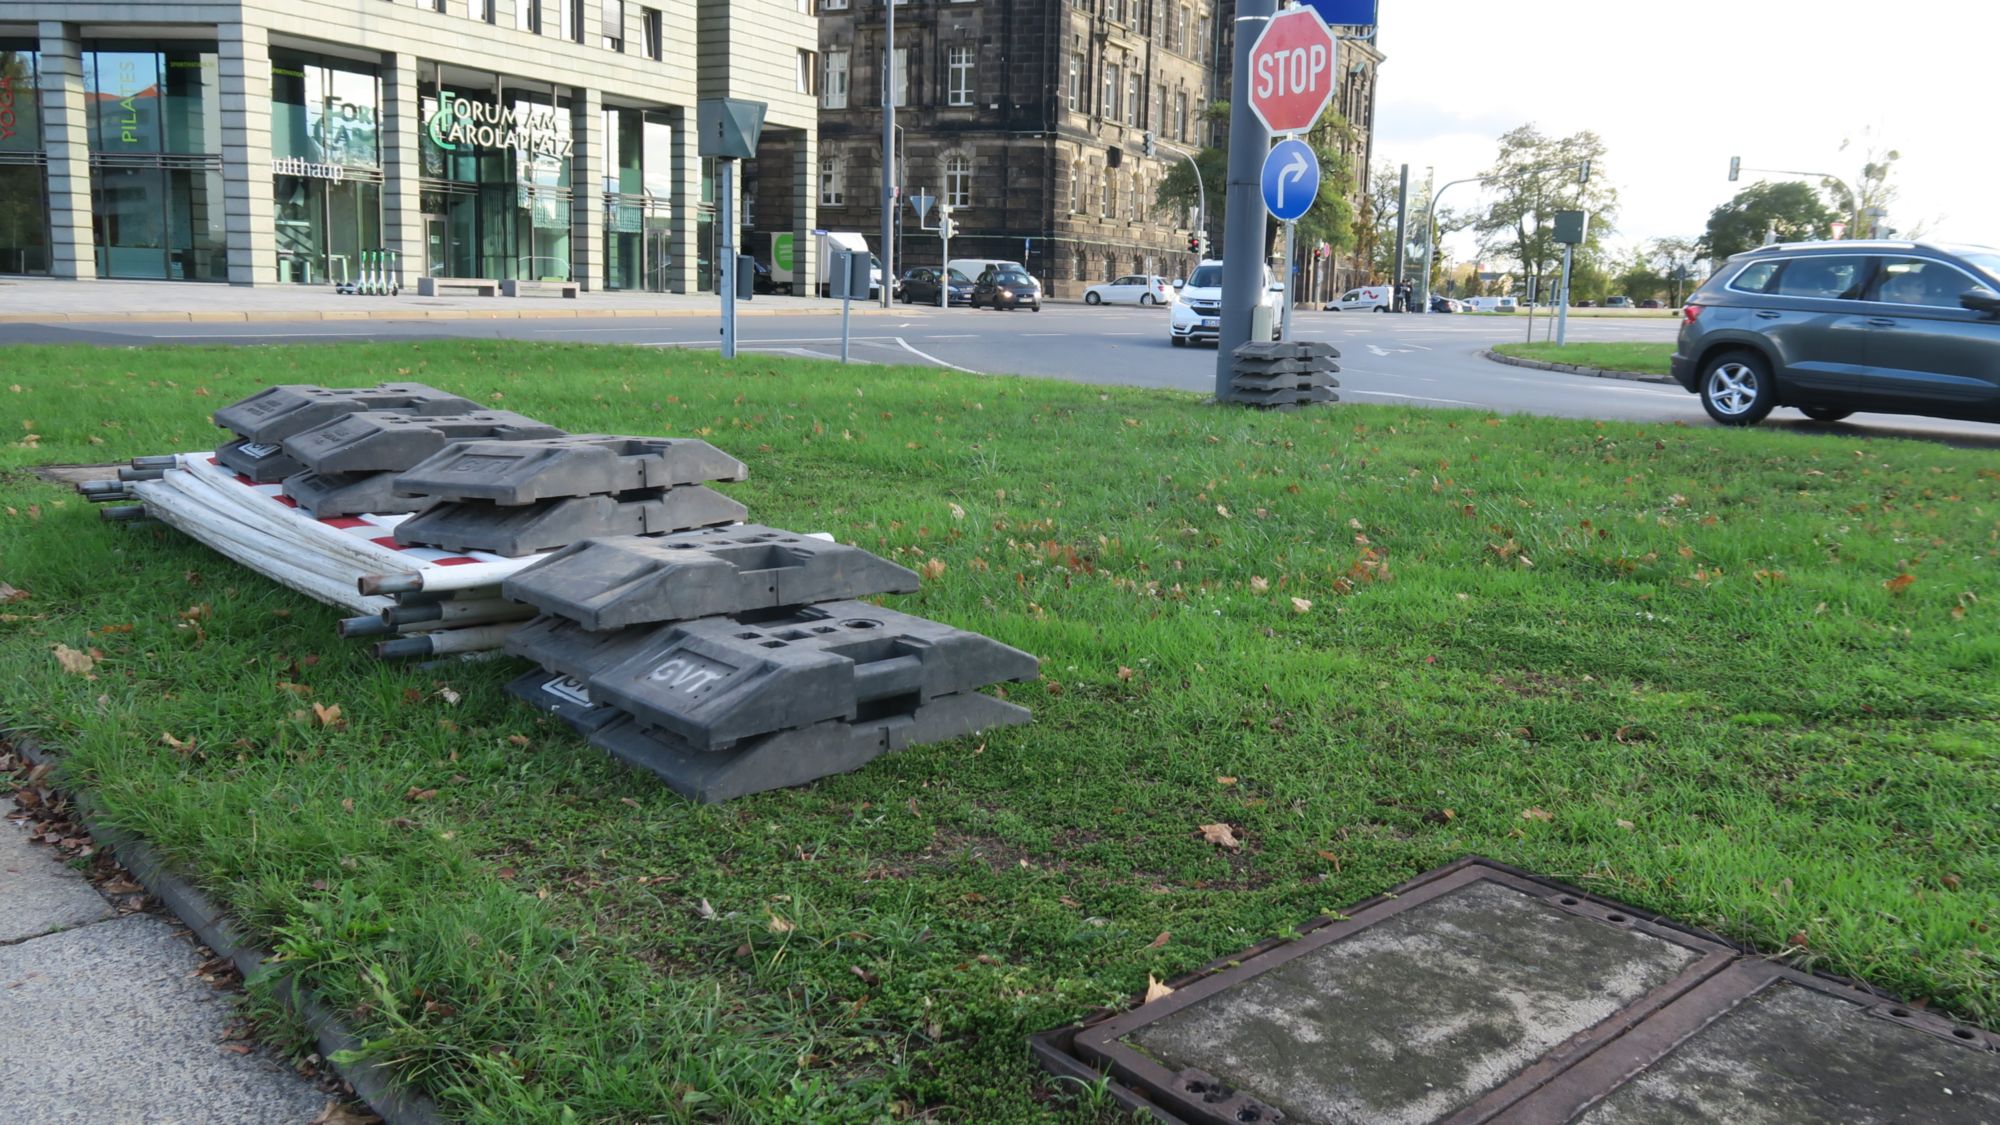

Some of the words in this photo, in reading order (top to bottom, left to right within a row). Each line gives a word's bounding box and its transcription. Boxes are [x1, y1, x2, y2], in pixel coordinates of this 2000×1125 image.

[1257, 44, 1326, 98] STOP
[0, 76, 16, 140] YOGA
[120, 61, 137, 143] PILATES
[440, 90, 520, 132] FORUM
[524, 108, 560, 134] AM
[429, 110, 574, 157] CAROLAPLATZ
[272, 154, 344, 185] ulthaup
[651, 659, 722, 694] GVT
